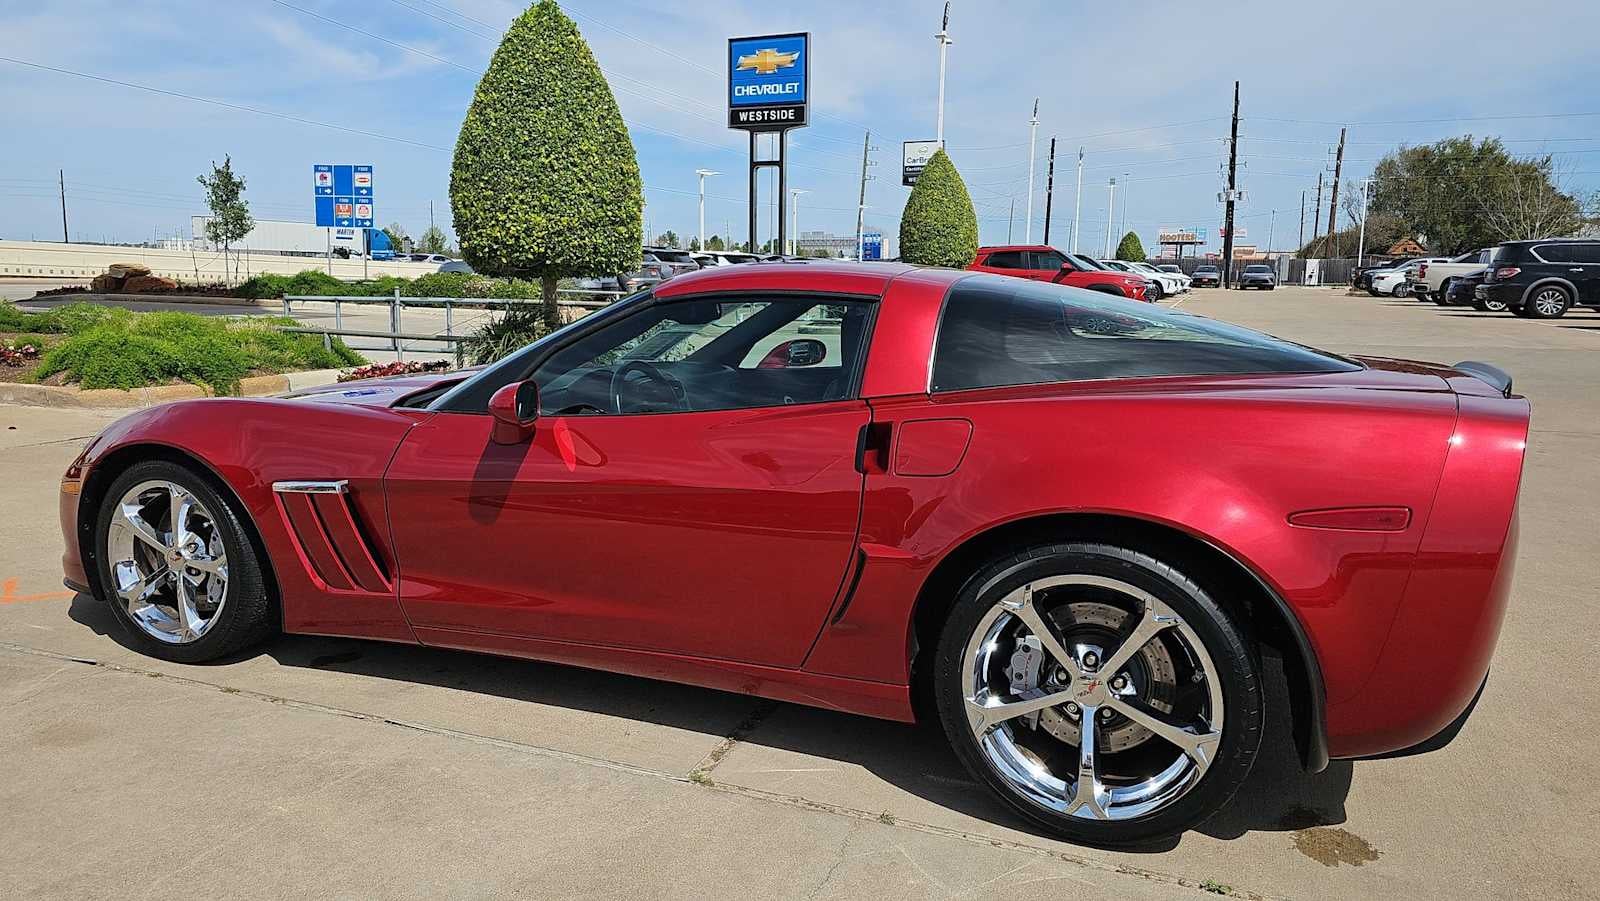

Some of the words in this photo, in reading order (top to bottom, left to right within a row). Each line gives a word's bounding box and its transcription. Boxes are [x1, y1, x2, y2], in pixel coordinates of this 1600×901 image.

[734, 82, 800, 97] CHEVROLET
[739, 109, 796, 122] WESTSIDE
[1160, 231, 1197, 241] HOOTERS
